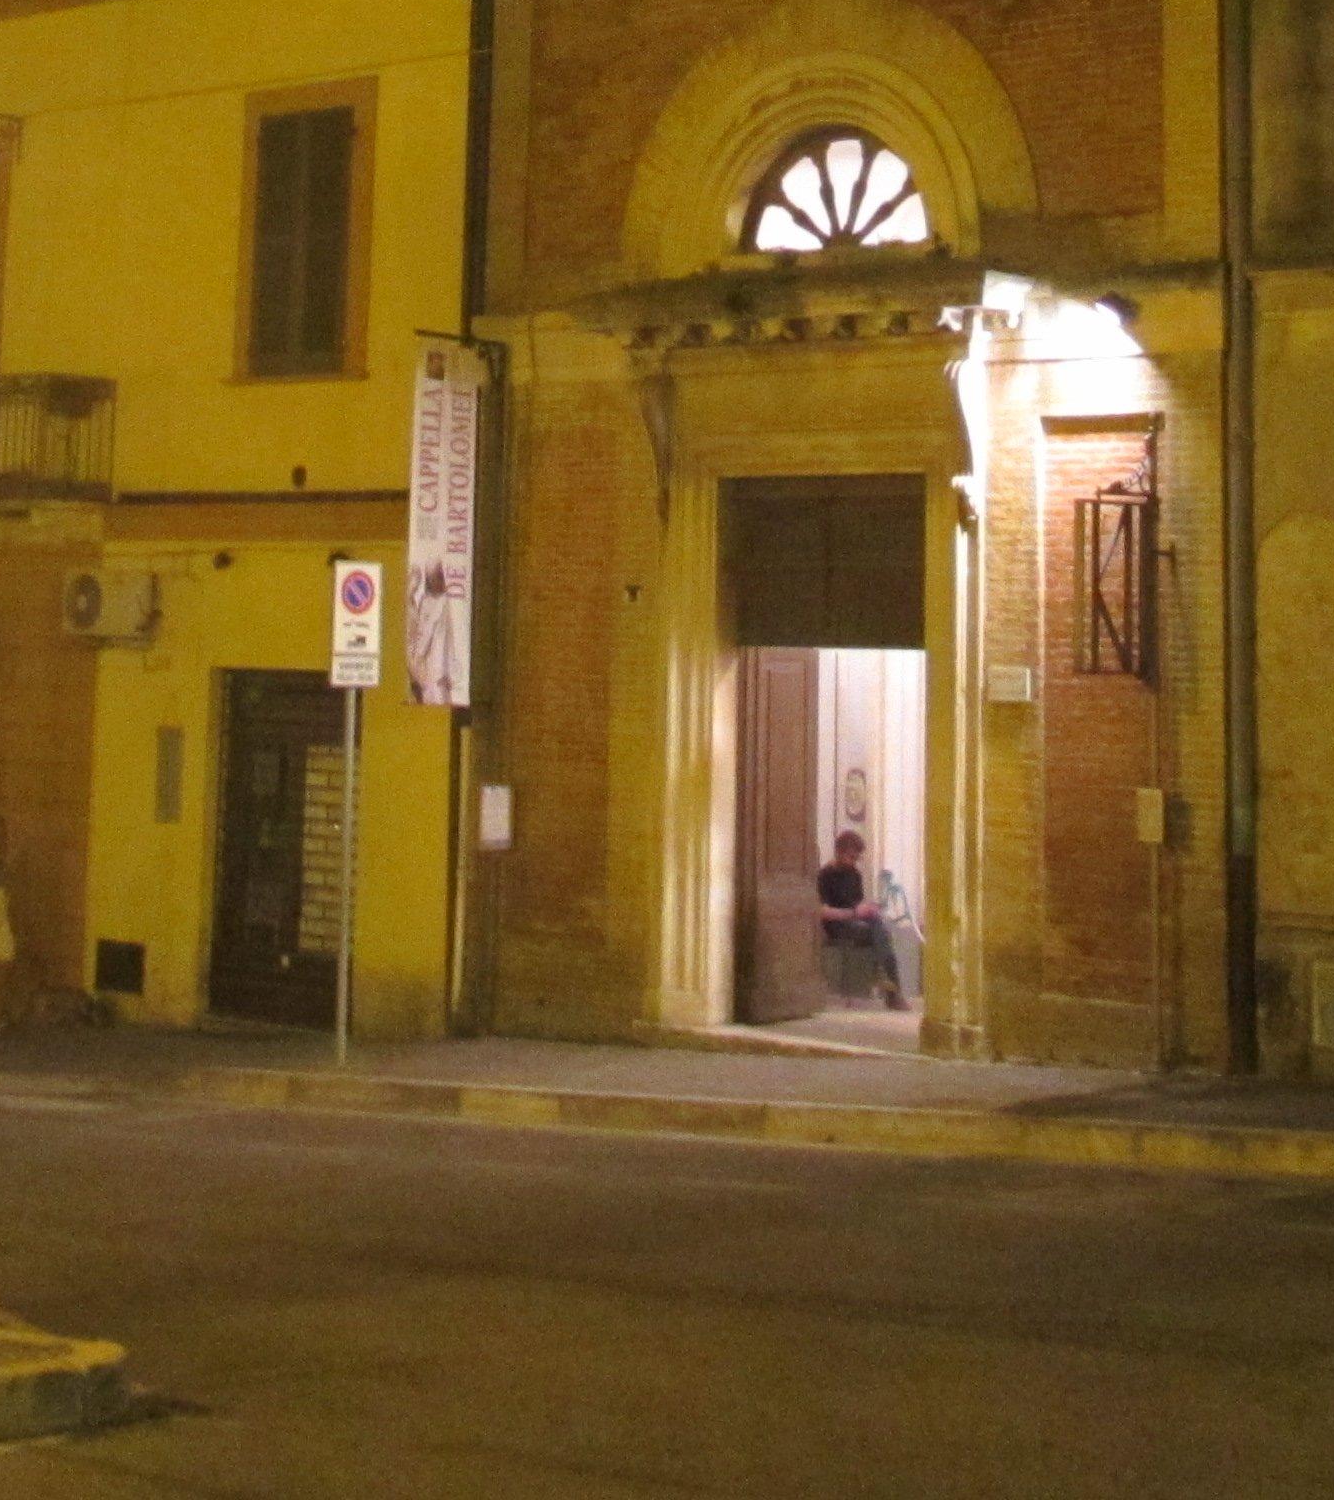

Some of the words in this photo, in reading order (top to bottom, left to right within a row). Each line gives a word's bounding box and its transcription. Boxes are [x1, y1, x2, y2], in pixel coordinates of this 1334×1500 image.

[418, 388, 442, 512] CAPPELLA
[447, 390, 472, 553] BARTOLOMEI
[446, 565, 466, 598] DE
